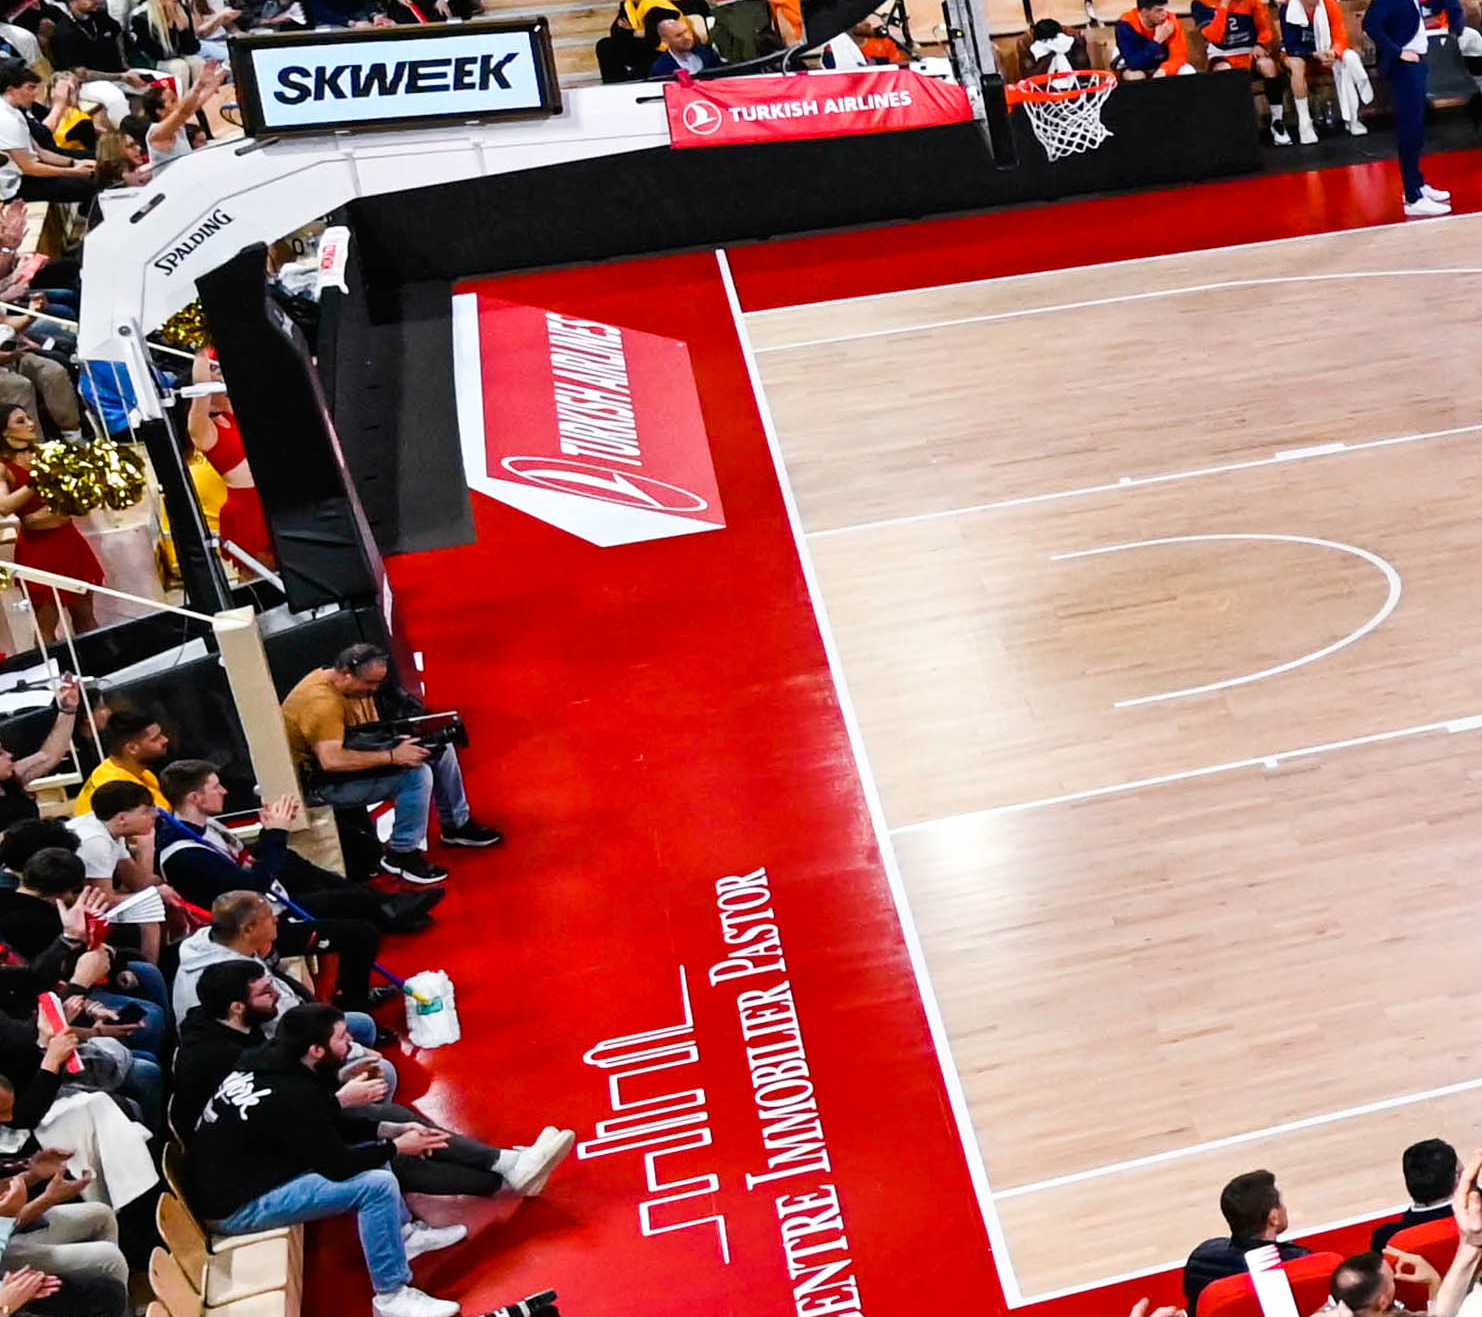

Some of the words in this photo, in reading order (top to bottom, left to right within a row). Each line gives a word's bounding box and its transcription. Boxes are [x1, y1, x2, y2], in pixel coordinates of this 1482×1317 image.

[1228, 17, 1239, 31] 2
[273, 52, 520, 105] SKWEEK
[729, 100, 818, 123] TURKISH
[824, 90, 913, 114] AIRLINES
[154, 208, 234, 276] SPALDING
[546, 311, 630, 394] AIRLINES
[554, 382, 643, 466] TURKISH
[709, 867, 786, 987] PASTOR
[736, 980, 831, 1191] IMMOBILIER
